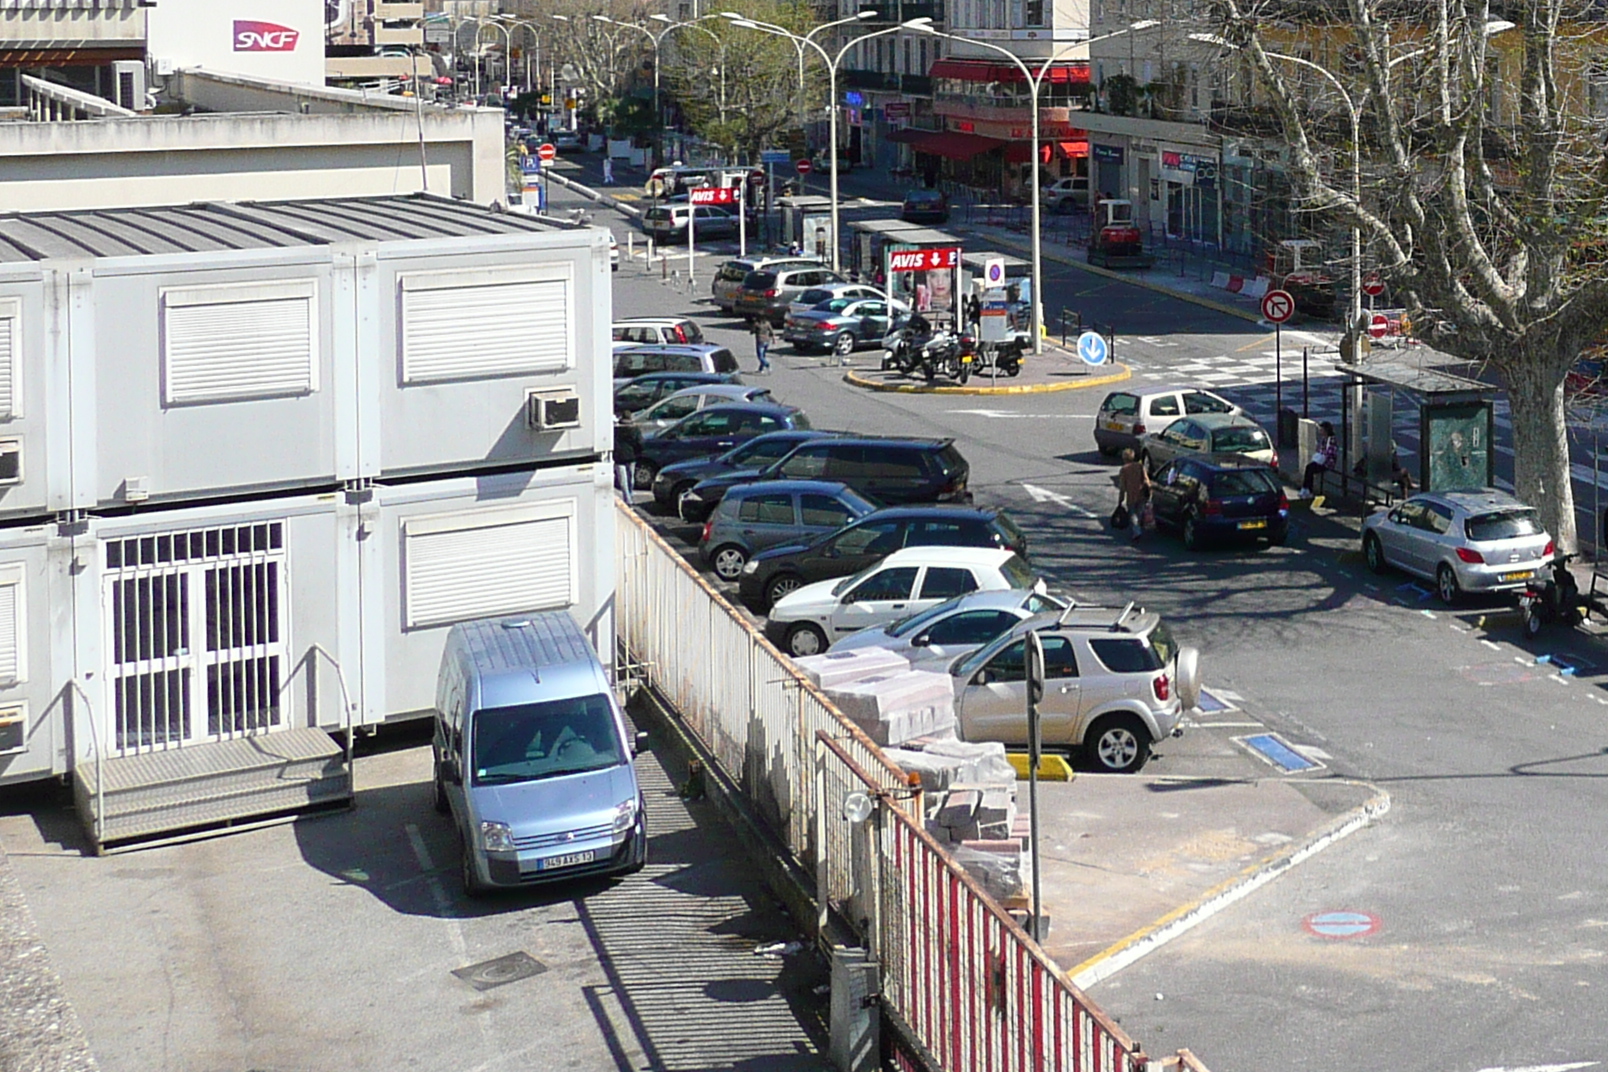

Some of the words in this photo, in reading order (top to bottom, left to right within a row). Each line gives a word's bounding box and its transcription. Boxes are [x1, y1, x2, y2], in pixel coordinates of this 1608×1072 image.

[235, 32, 297, 48] SNCF
[691, 190, 715, 202] AVIS
[891, 252, 925, 269] AVIS
